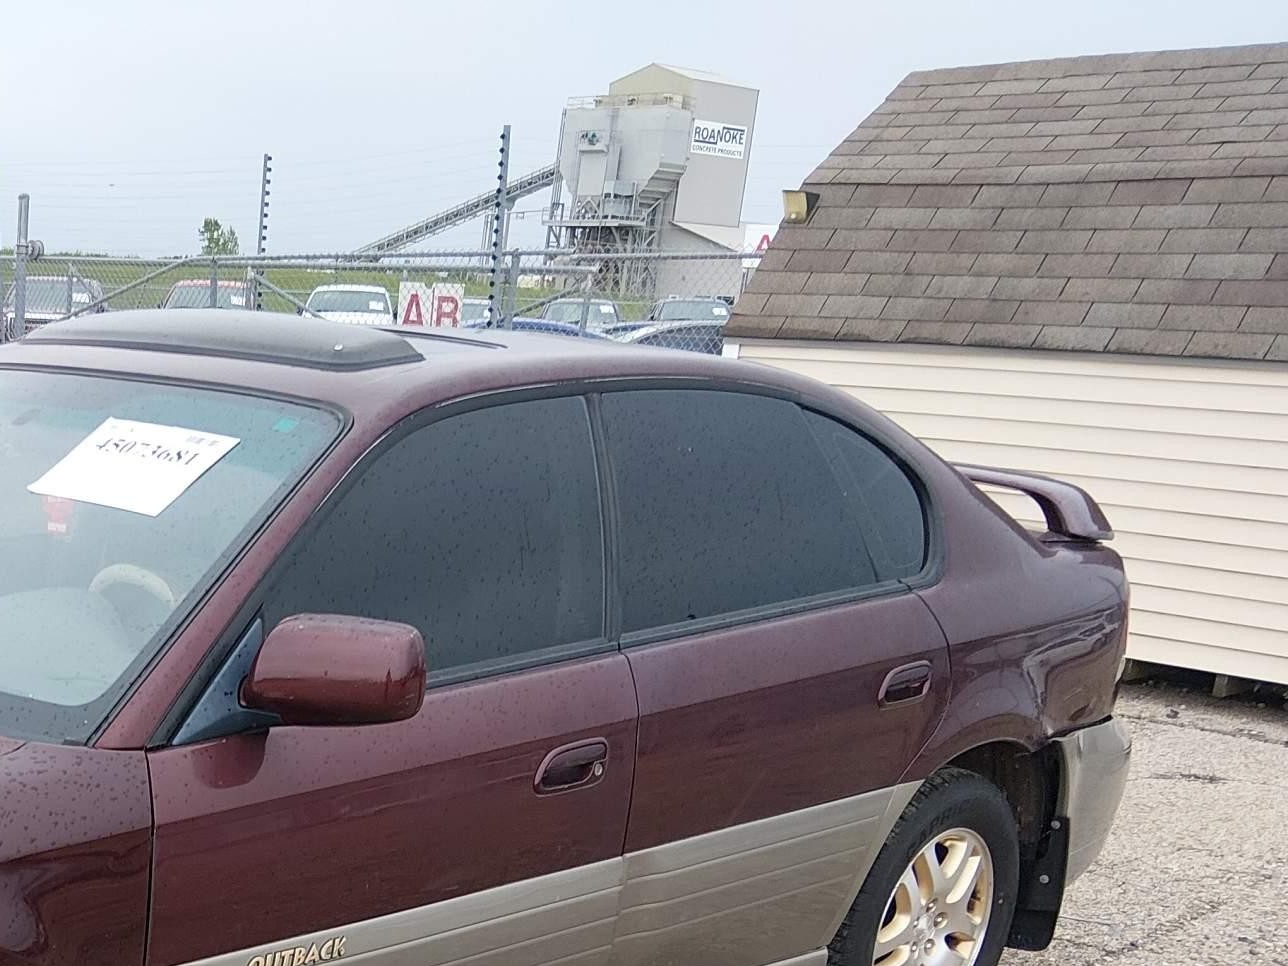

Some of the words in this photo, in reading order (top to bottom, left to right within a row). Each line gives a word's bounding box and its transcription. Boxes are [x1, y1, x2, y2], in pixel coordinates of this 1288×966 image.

[693, 126, 745, 145] ROANOKE
[692, 144, 717, 154] CONCRETE
[717, 147, 742, 158] PRODUCTS
